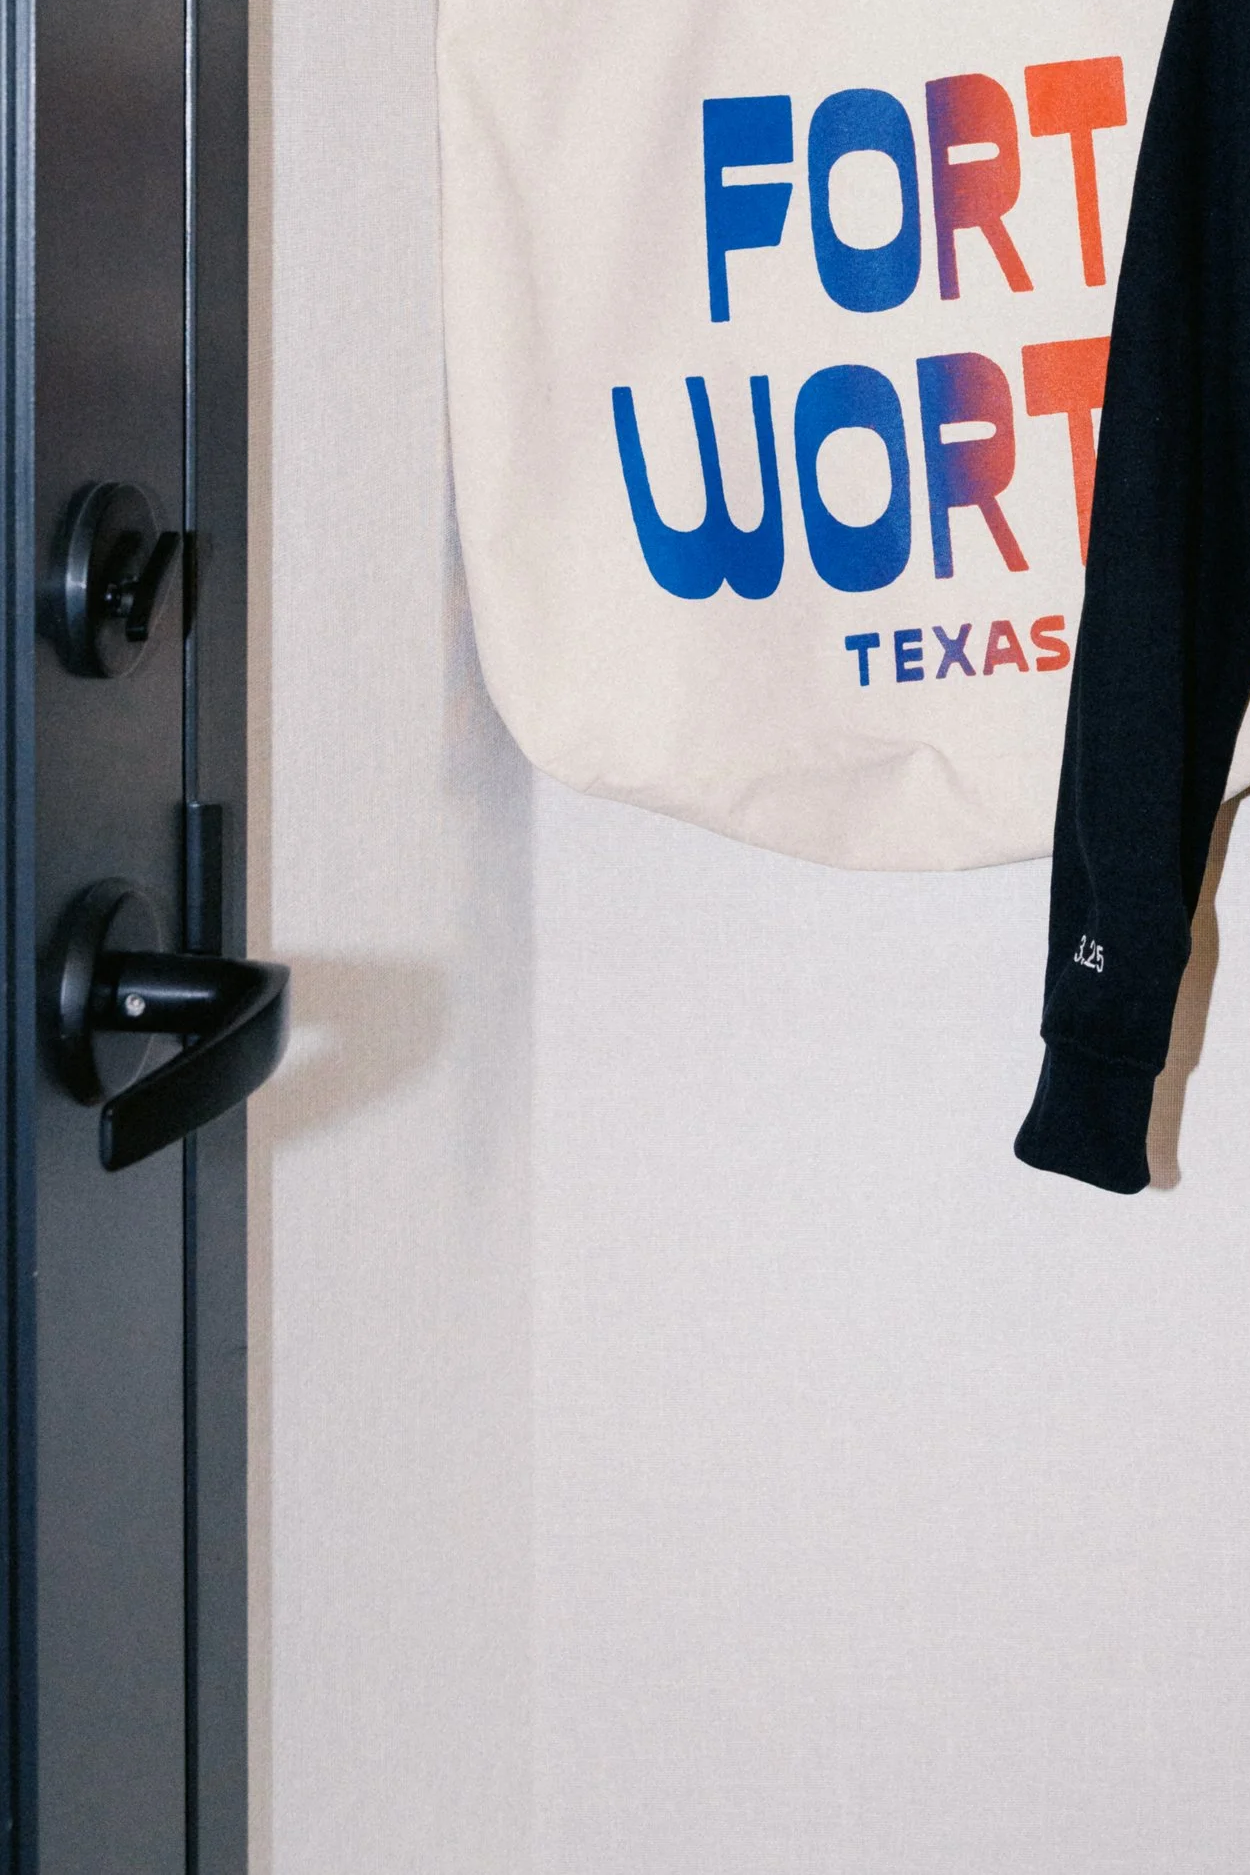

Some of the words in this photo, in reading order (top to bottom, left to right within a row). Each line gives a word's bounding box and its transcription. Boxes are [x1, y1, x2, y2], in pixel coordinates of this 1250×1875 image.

[702, 55, 1128, 323] FORT
[611, 335, 1112, 600] WORT
[844, 614, 1071, 686] TEXAS
